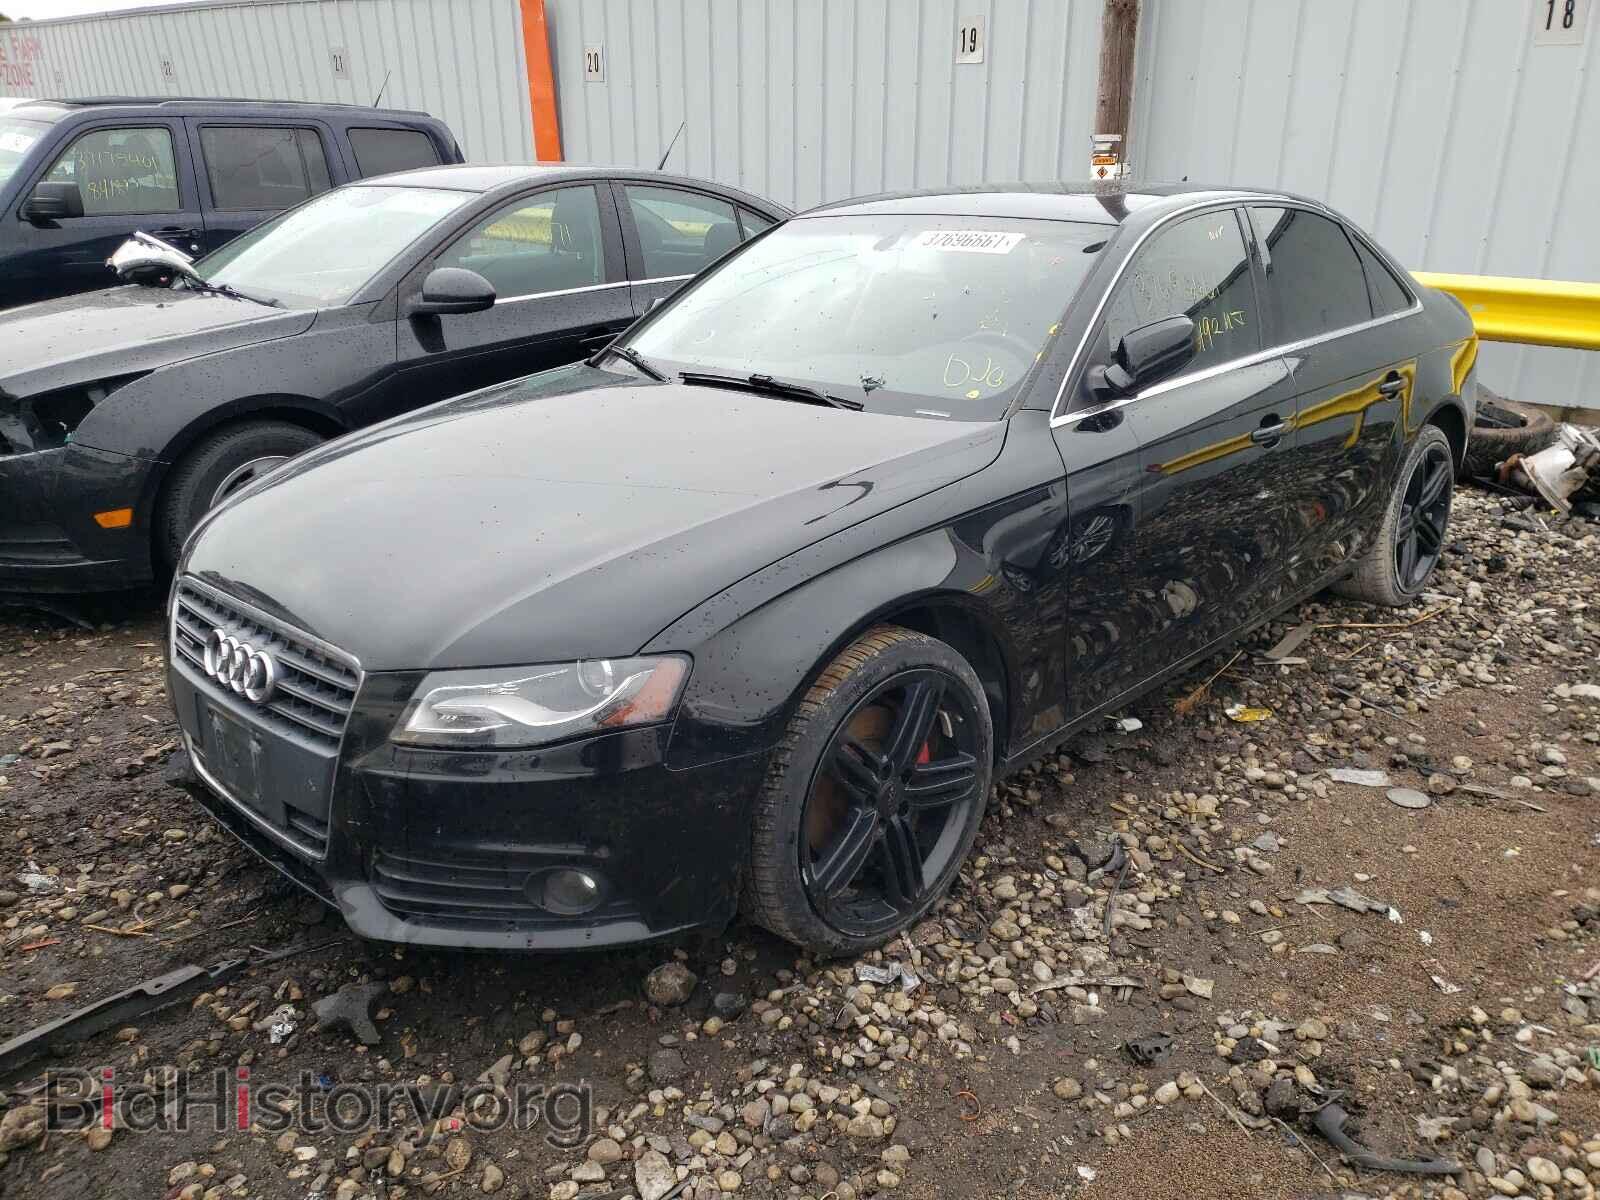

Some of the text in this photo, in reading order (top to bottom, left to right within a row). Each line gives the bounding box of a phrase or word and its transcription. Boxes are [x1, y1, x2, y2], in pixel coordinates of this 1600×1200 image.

[1545, 0, 1575, 30] 18
[961, 27, 977, 53] 19
[587, 52, 599, 73] 20
